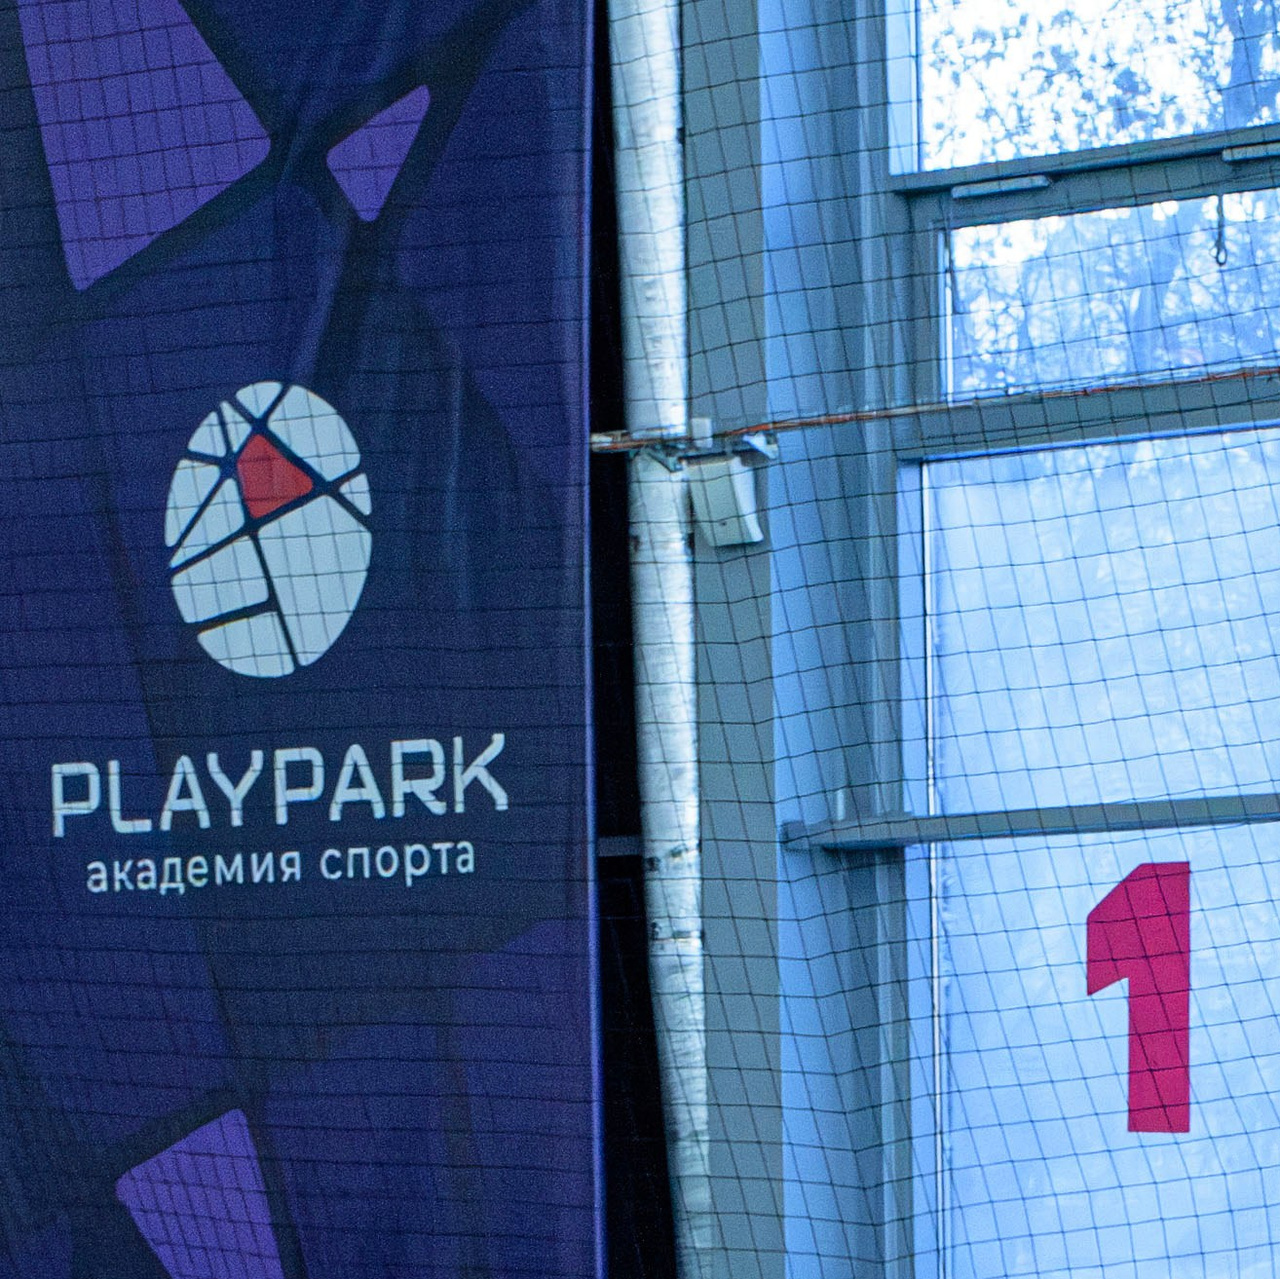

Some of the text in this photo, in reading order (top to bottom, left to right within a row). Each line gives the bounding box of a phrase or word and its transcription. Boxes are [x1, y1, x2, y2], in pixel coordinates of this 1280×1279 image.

[52, 733, 508, 838] PLAYPARK
[86, 840, 475, 895] академия спорта
[1087, 861, 1190, 1132] 1
